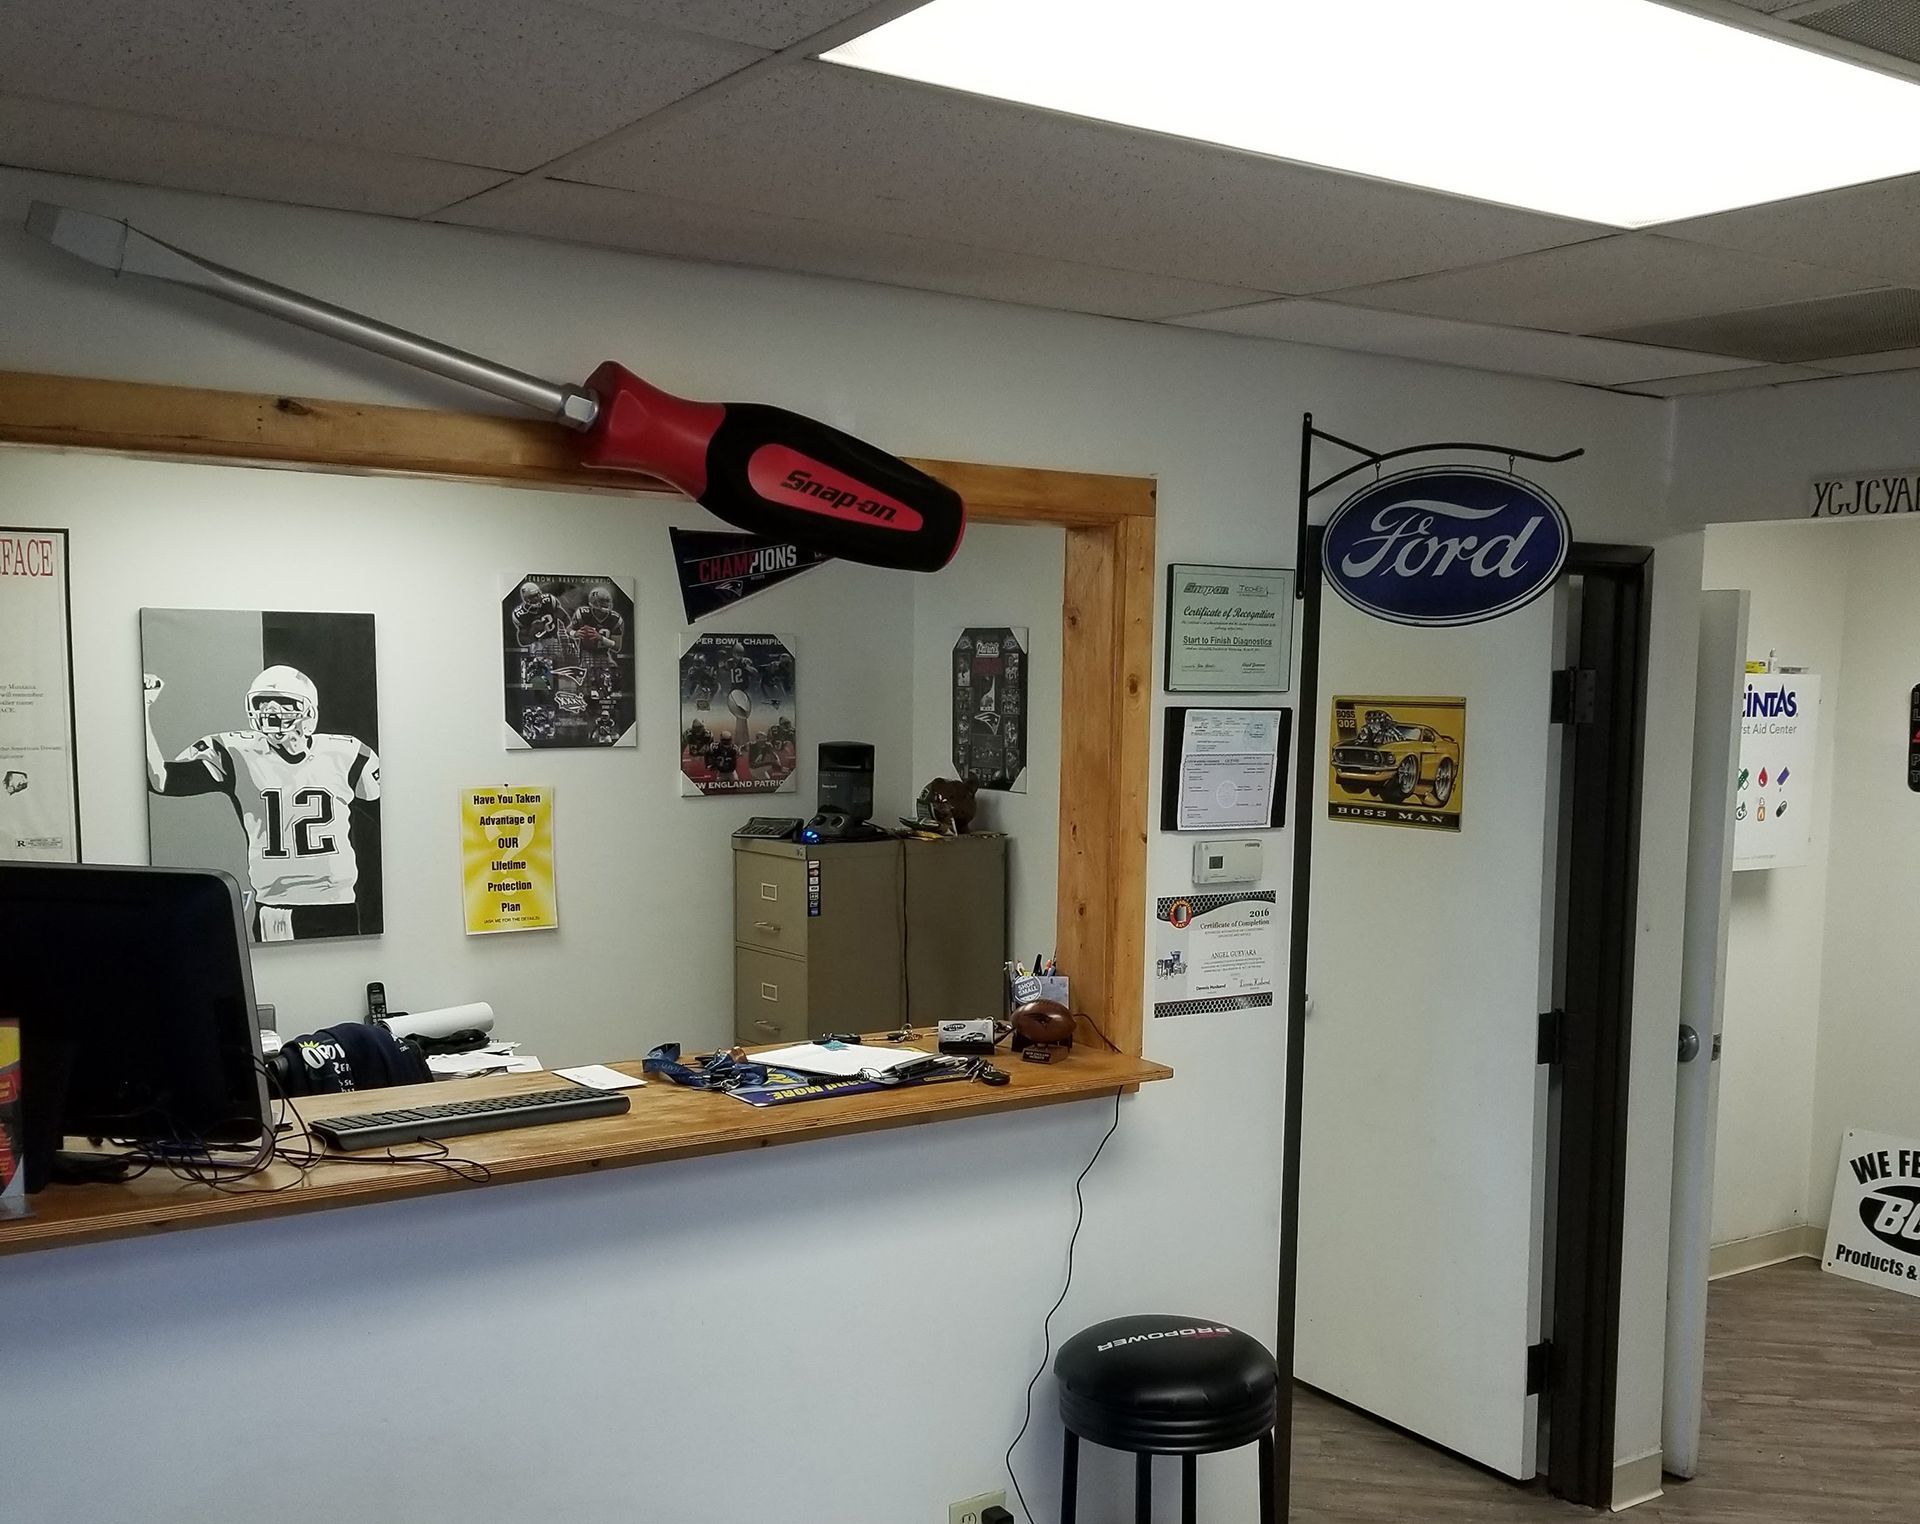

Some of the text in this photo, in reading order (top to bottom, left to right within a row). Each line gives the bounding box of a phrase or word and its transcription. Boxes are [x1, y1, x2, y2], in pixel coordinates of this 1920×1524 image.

[780, 469, 897, 523] Snap-on
[1341, 500, 1544, 578] Ford
[699, 545, 797, 582] CHAMPIONS
[1183, 606, 1275, 620] Certificate of Recognition
[1183, 636, 1272, 647] Start to Finish Diagnostics
[1336, 710, 1356, 718] BOSS
[1338, 719, 1356, 728] 302
[1752, 723, 1767, 734] Aid
[1769, 723, 1797, 734] Center
[708, 781, 752, 789] ENGLAND
[473, 793, 541, 804] Have You Taken
[480, 814, 536, 825] Advantage of
[1337, 806, 1444, 823] BOSS MAN
[260, 787, 339, 858] 12
[498, 837, 519, 848] OUR
[491, 860, 526, 871] Lifetime
[488, 880, 532, 892] Protection
[501, 902, 521, 912] Plan
[1249, 907, 1270, 918] 2016
[1200, 919, 1270, 930] Certificate of Completion
[1849, 1150, 1892, 1185] WE
[1836, 1243, 1918, 1281] Products &
[1097, 1326, 1233, 1352] PROPOWER
